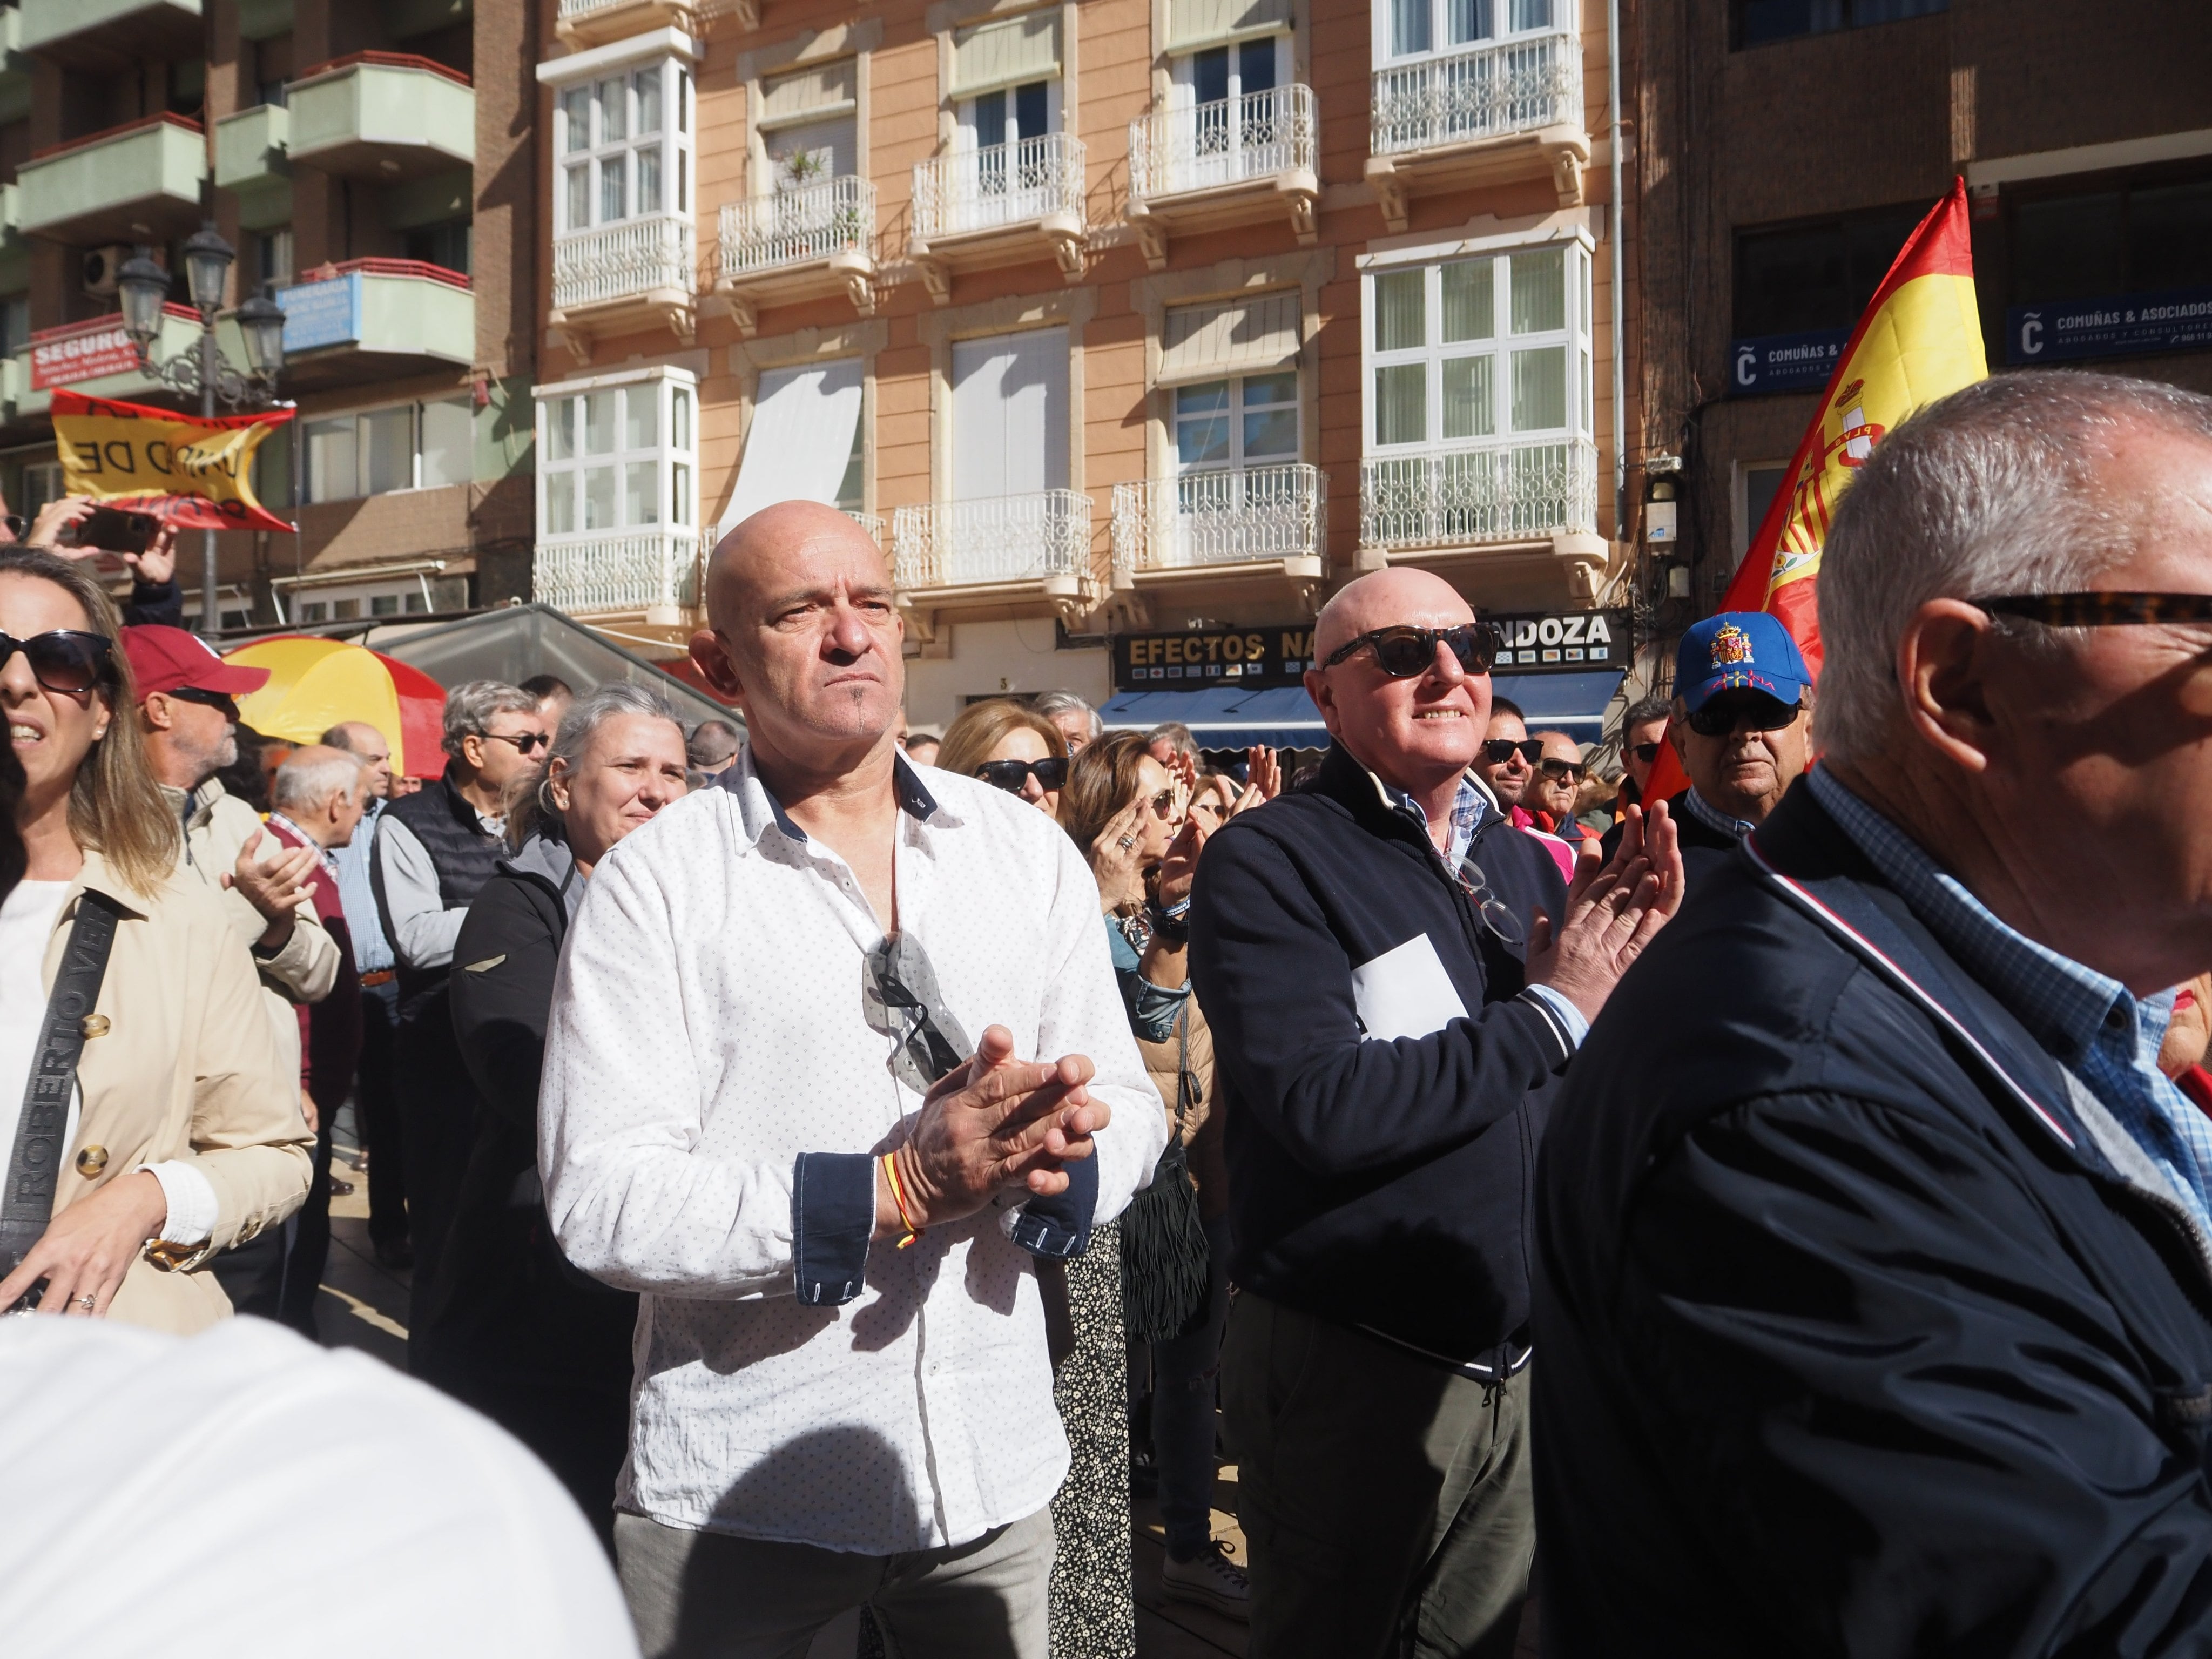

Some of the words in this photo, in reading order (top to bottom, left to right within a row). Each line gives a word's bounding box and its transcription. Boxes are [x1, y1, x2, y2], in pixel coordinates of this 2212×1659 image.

[2058, 311, 2120, 329] COMUÑAS
[2126, 310, 2135, 323] &
[2141, 301, 2212, 321] ASOCIADOS
[2058, 332, 2116, 343] ABOGADOS
[2134, 323, 2212, 336] CONSULTORE
[1768, 344, 1825, 363] COMUÑAS
[1829, 343, 1838, 356] &
[1769, 365, 1821, 376] ABOGADOS
[1130, 633, 1265, 665] EFECTOS
[1000, 677, 1007, 690] 3
[15, 991, 87, 1205] ROBERTO
